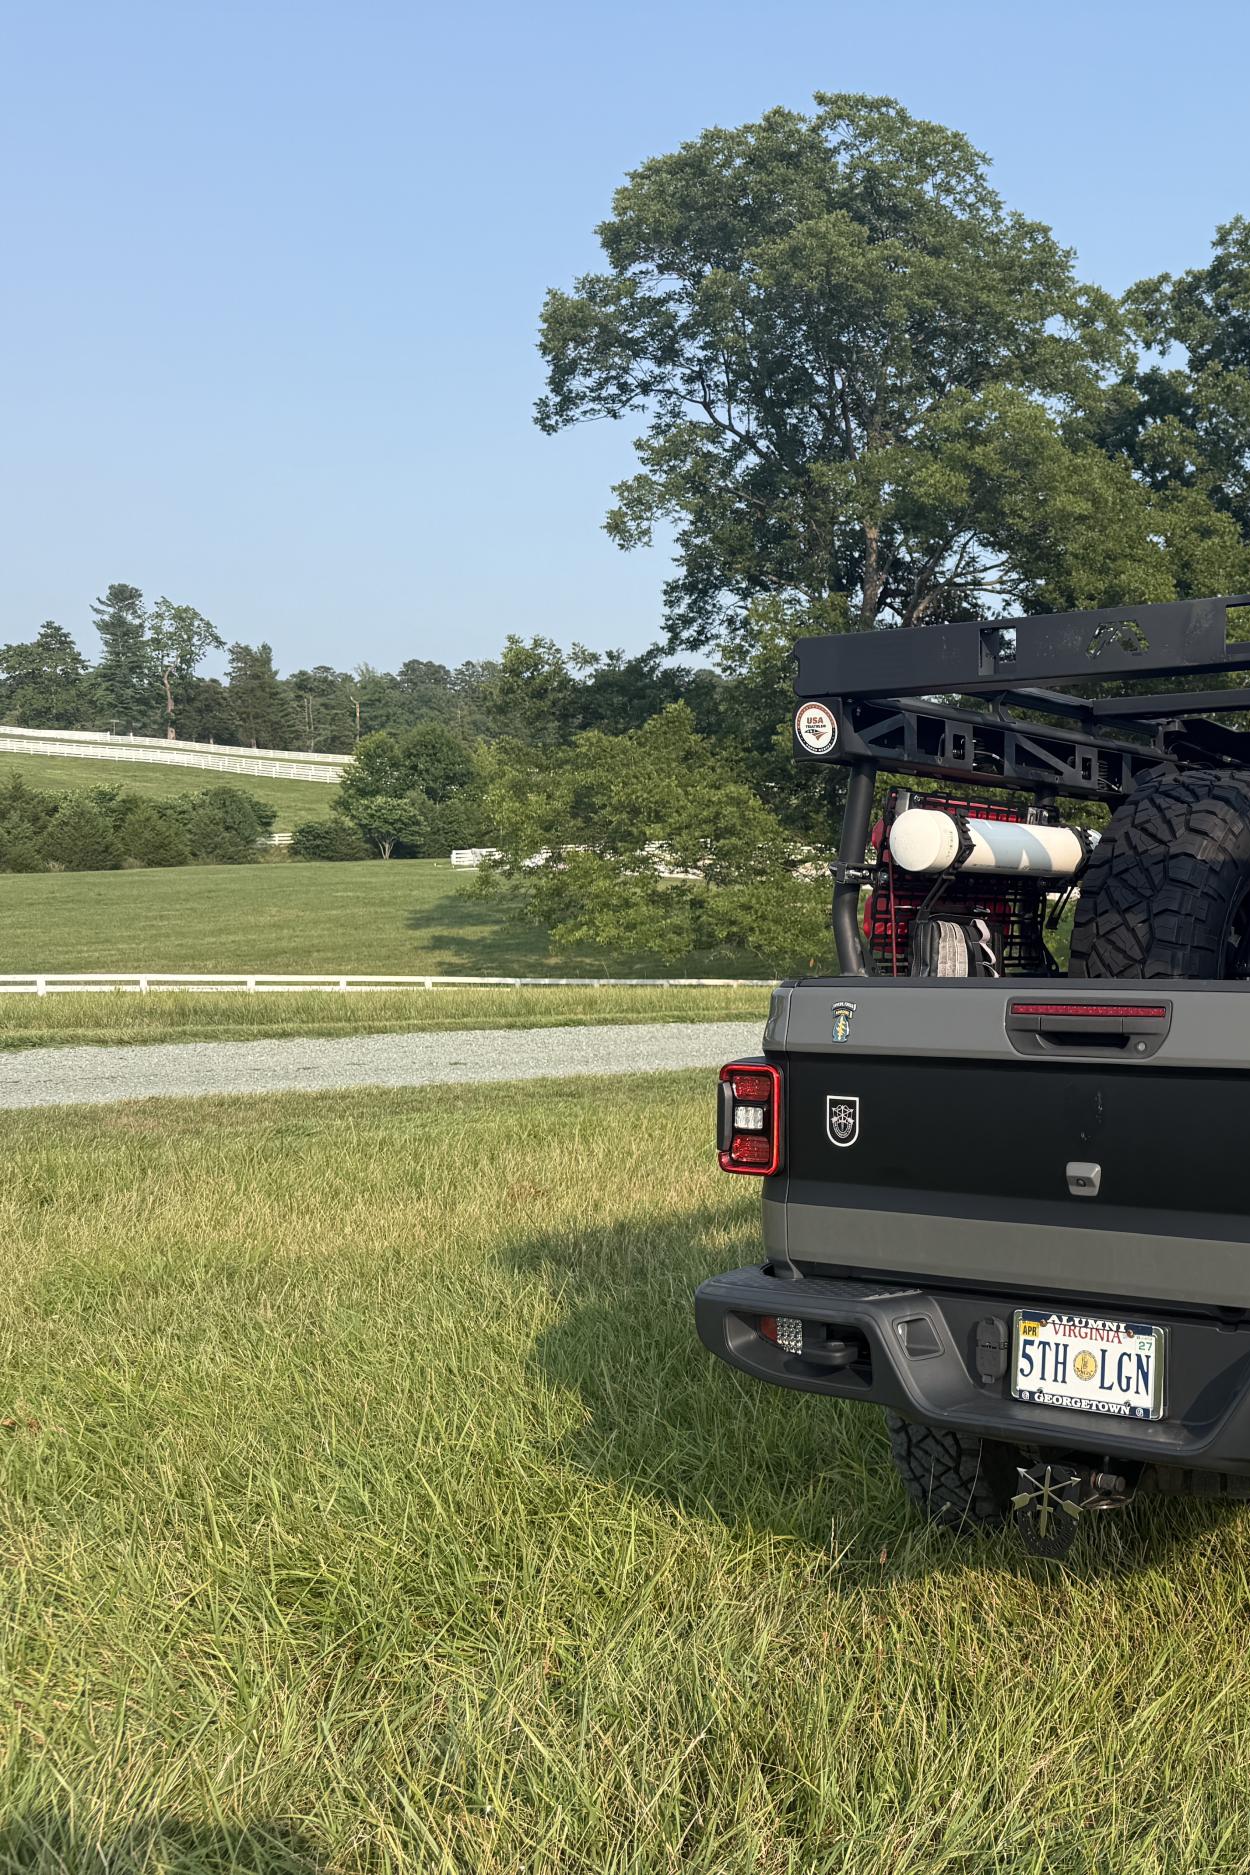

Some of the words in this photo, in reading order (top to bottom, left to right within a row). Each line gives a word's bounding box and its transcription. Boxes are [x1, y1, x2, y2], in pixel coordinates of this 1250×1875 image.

[1022, 1325, 1037, 1336] APR
[1047, 1314, 1127, 1332] ALUMNI
[1052, 1323, 1123, 1344] VIRGINIA
[1138, 1341, 1153, 1351] 27
[1019, 1338, 1069, 1385] 5TH
[1099, 1348, 1152, 1397] LGN
[1034, 1393, 1131, 1415] GEORGETOWN
